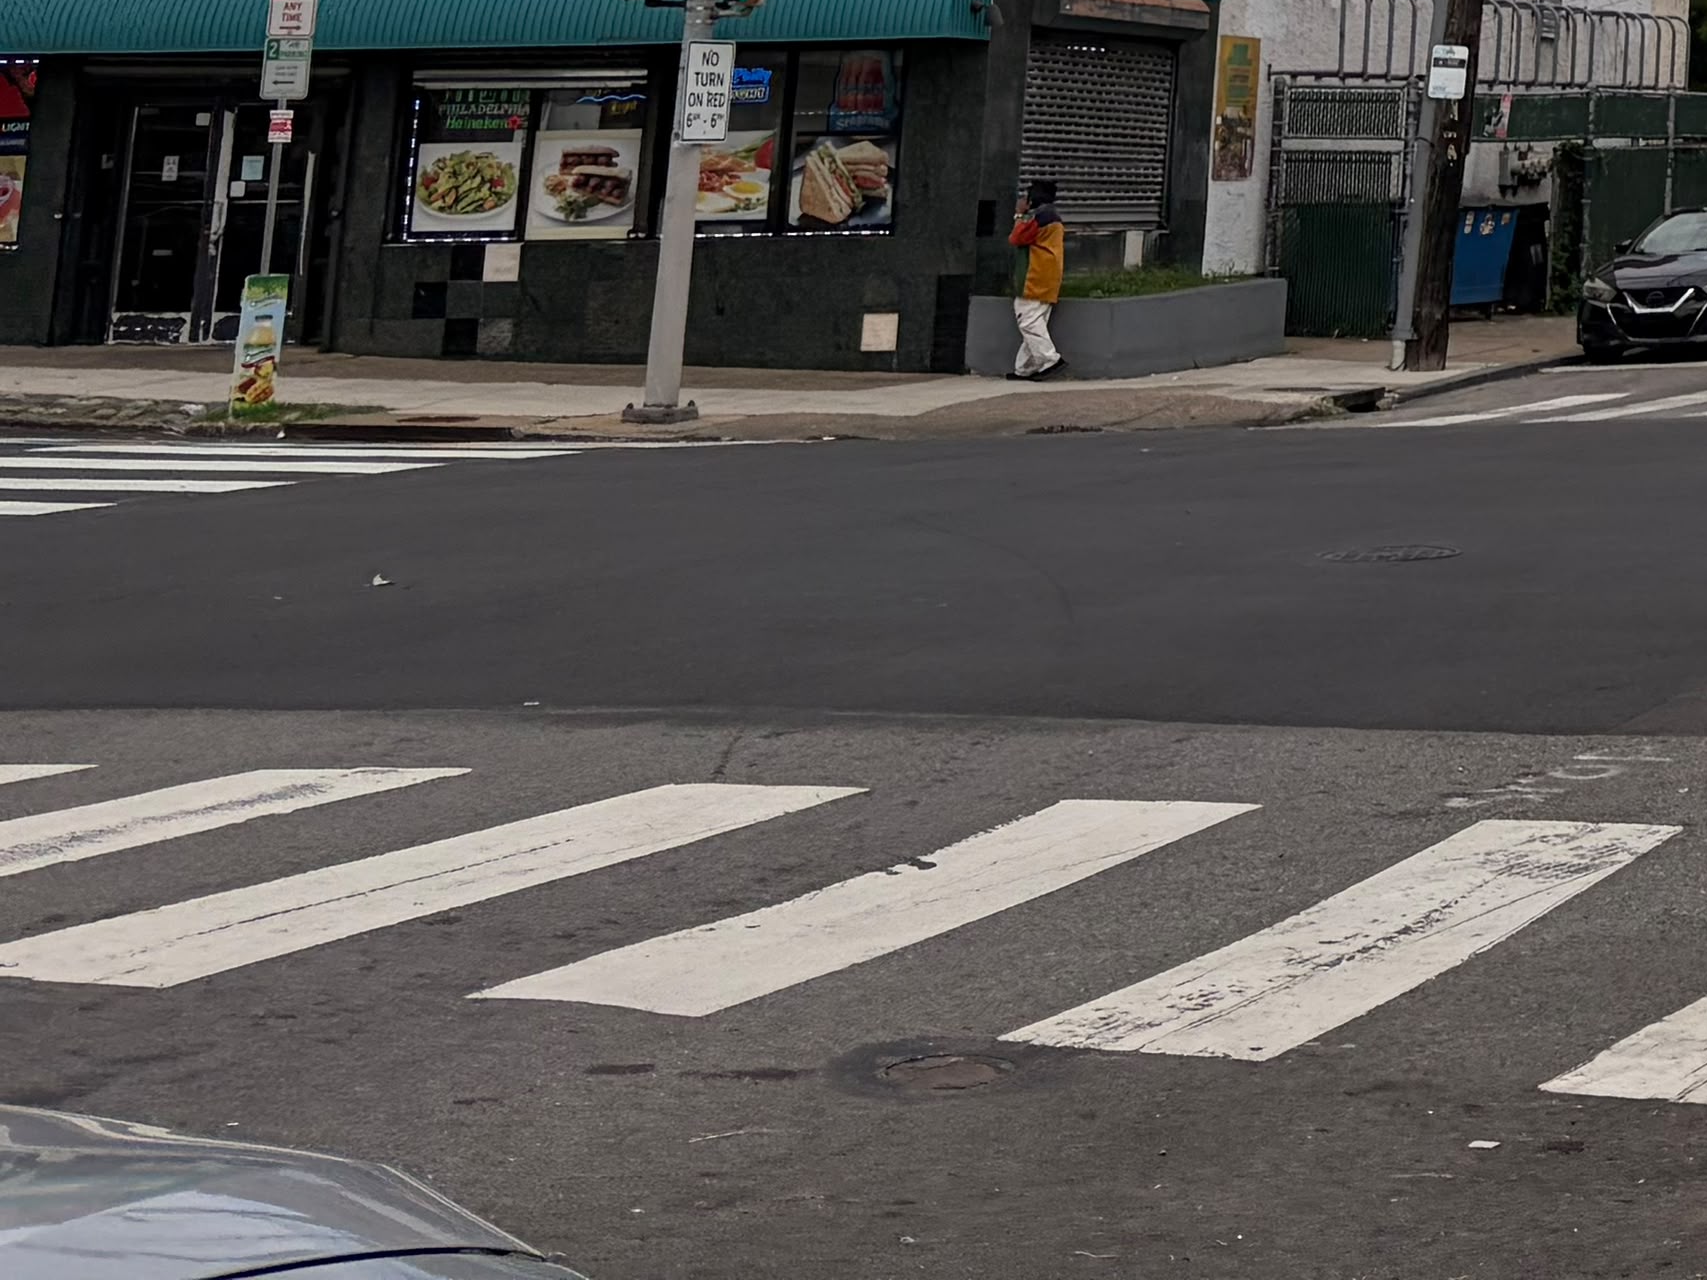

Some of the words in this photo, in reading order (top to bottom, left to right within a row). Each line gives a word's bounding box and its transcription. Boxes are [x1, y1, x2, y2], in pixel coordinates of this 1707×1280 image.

[284, 2, 302, 11] ANY
[281, 12, 303, 23] TIME
[269, 41, 278, 58] 2
[702, 51, 720, 66] NO
[694, 72, 725, 86] TURN
[688, 93, 703, 107] ON
[706, 91, 725, 108] RED
